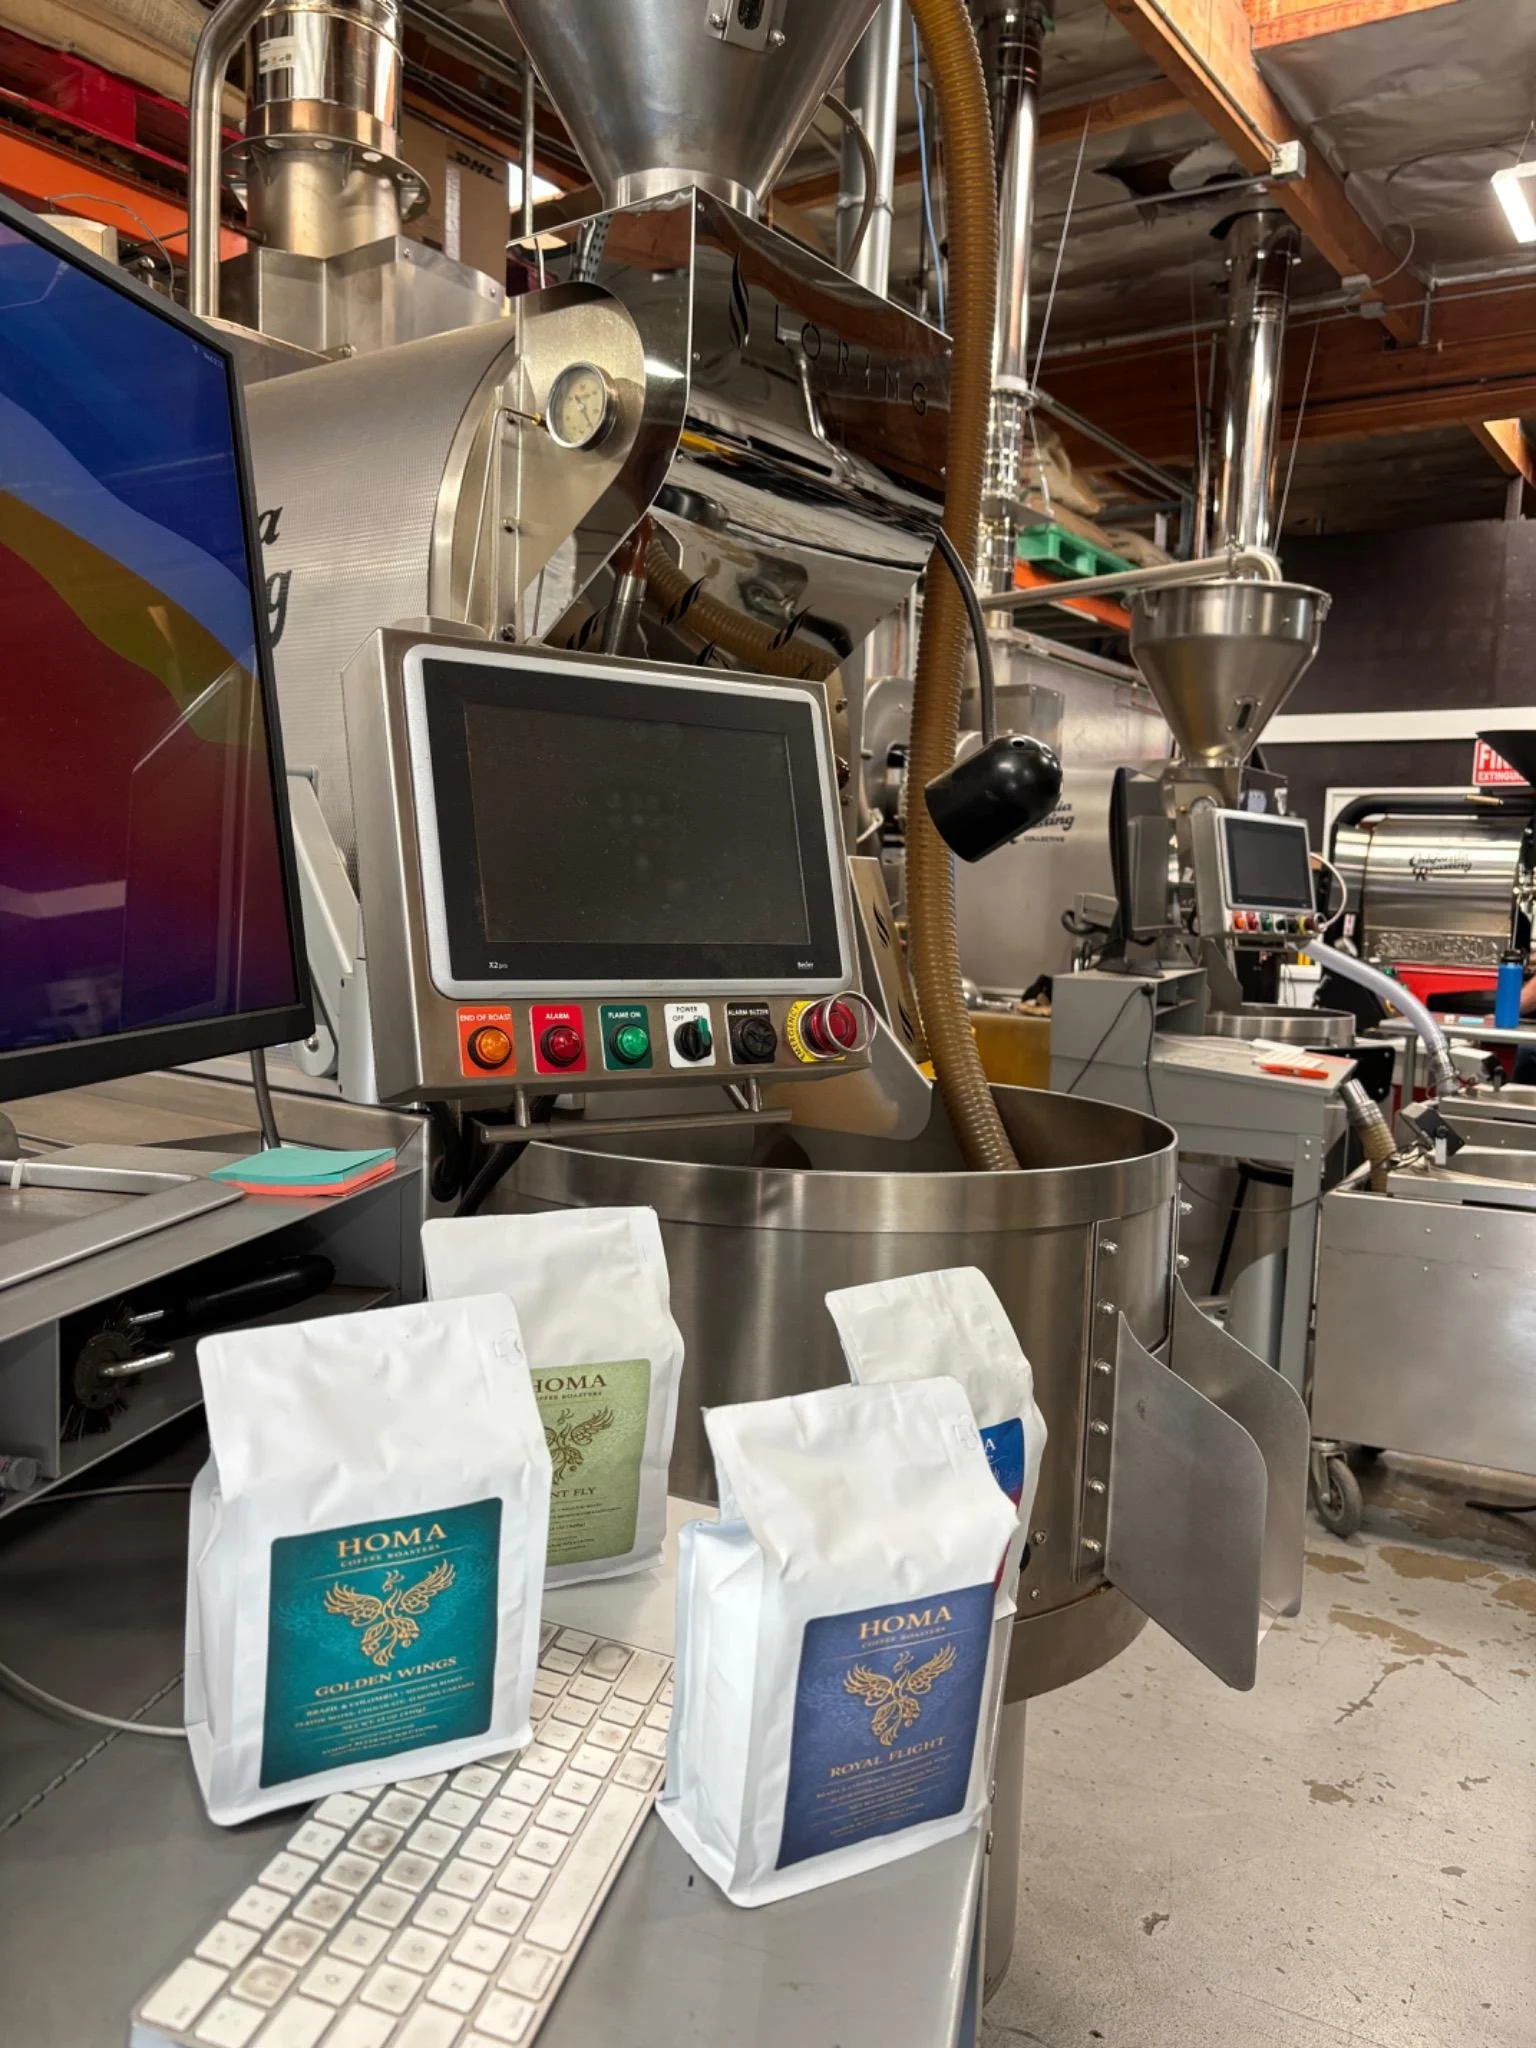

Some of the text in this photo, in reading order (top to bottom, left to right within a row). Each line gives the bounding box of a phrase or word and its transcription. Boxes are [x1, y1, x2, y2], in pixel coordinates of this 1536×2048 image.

[774, 304, 928, 416] LORING
[459, 1014, 475, 1022] END
[488, 1013, 512, 1021] ROAST
[545, 1012, 570, 1020] ALARM
[607, 1011, 642, 1019] FLAME ON
[573, 1487, 597, 1497] FLY
[337, 1523, 448, 1558] HOMA
[859, 1605, 953, 1640] HOMA
[314, 1656, 458, 1697] GOLDEN WINGS
[829, 1736, 947, 1778] ROYAL FLIGHT
